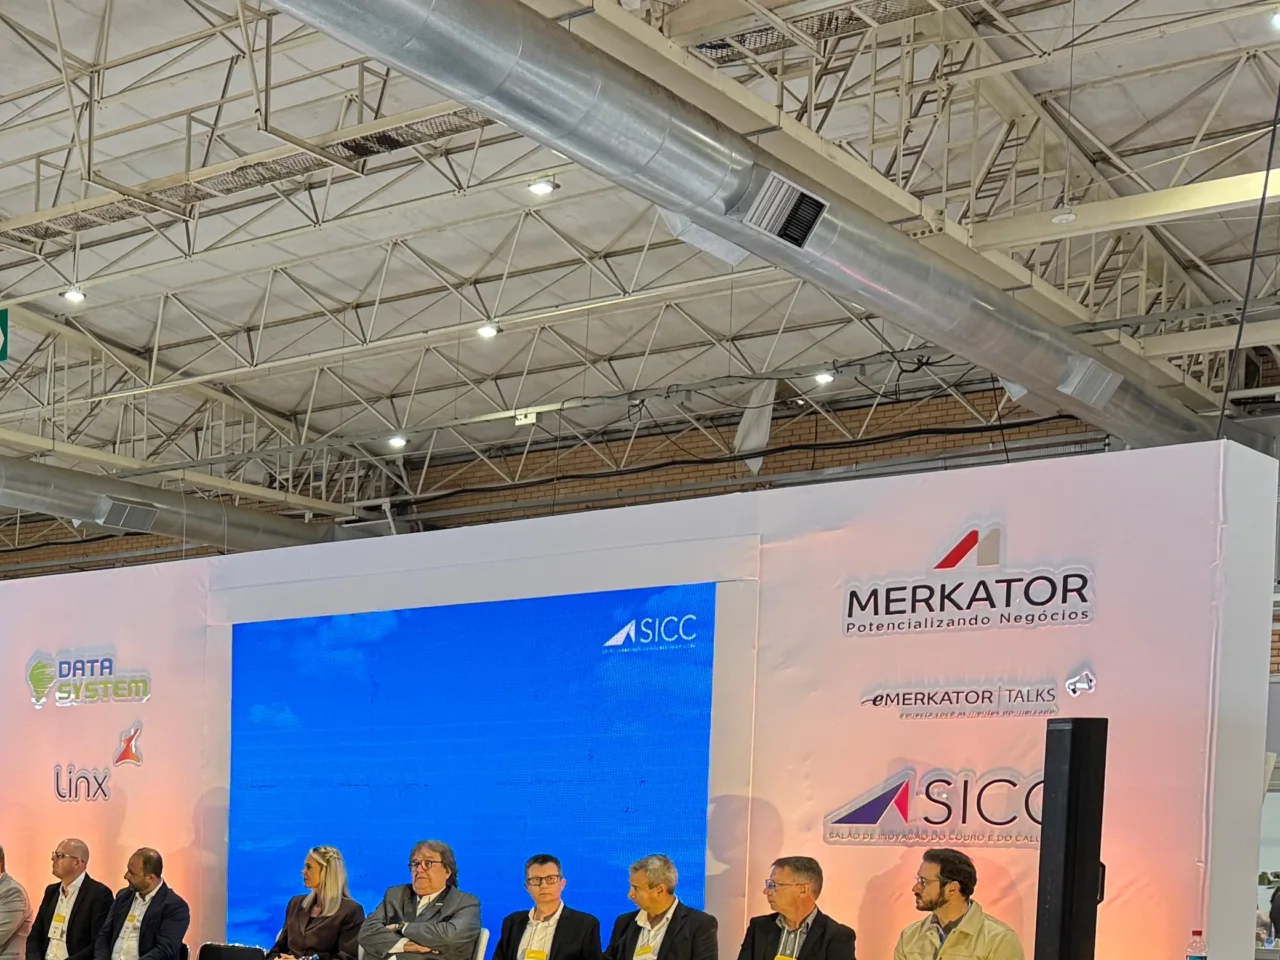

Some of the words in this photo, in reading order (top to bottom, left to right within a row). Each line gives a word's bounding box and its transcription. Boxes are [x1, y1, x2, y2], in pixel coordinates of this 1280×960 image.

[847, 573, 1089, 618] MERKATOR
[640, 614, 697, 643] SICC
[846, 615, 991, 634] Potencializando
[1000, 609, 1089, 625] Negócios
[58, 658, 113, 678] DATA
[58, 679, 148, 700] SYSTEM
[1005, 688, 1056, 703] TALKS
[828, 831, 860, 840] SALÃO
[862, 832, 877, 840] DE
[931, 833, 946, 841] DO
[948, 833, 985, 841] COURO
[987, 834, 995, 842] E
[997, 834, 1013, 842] DO
